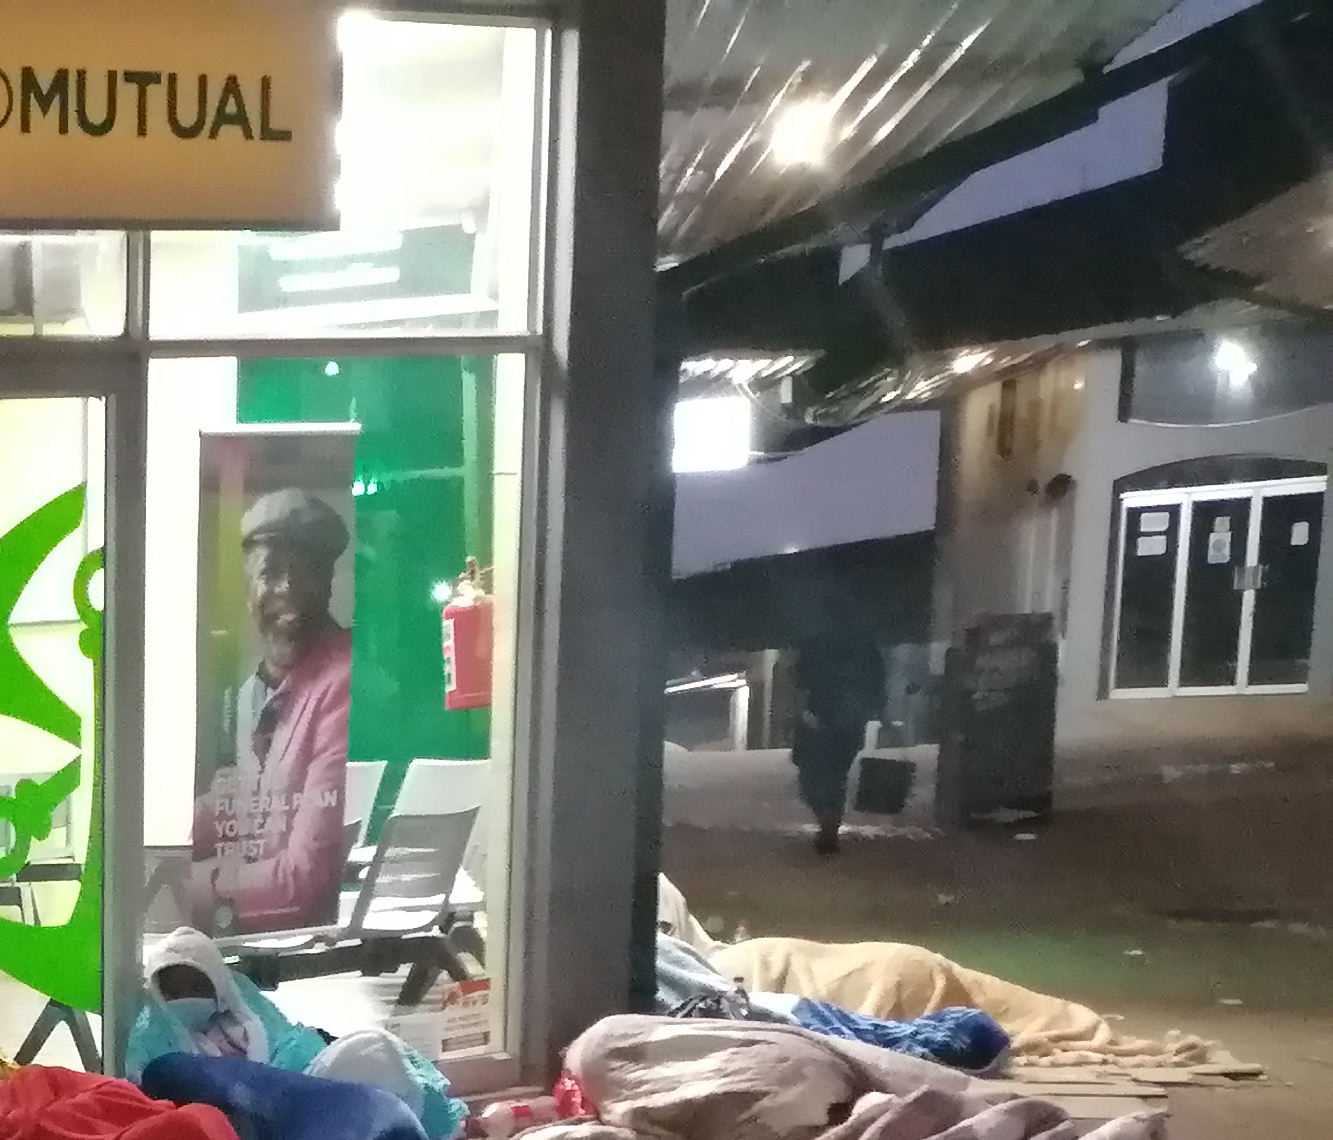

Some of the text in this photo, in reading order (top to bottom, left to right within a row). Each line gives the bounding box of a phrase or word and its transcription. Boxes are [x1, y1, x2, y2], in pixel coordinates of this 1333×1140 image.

[215, 789, 339, 817] FUERAL PAN
[213, 819, 247, 839] YO
[213, 838, 267, 859] TRUST
